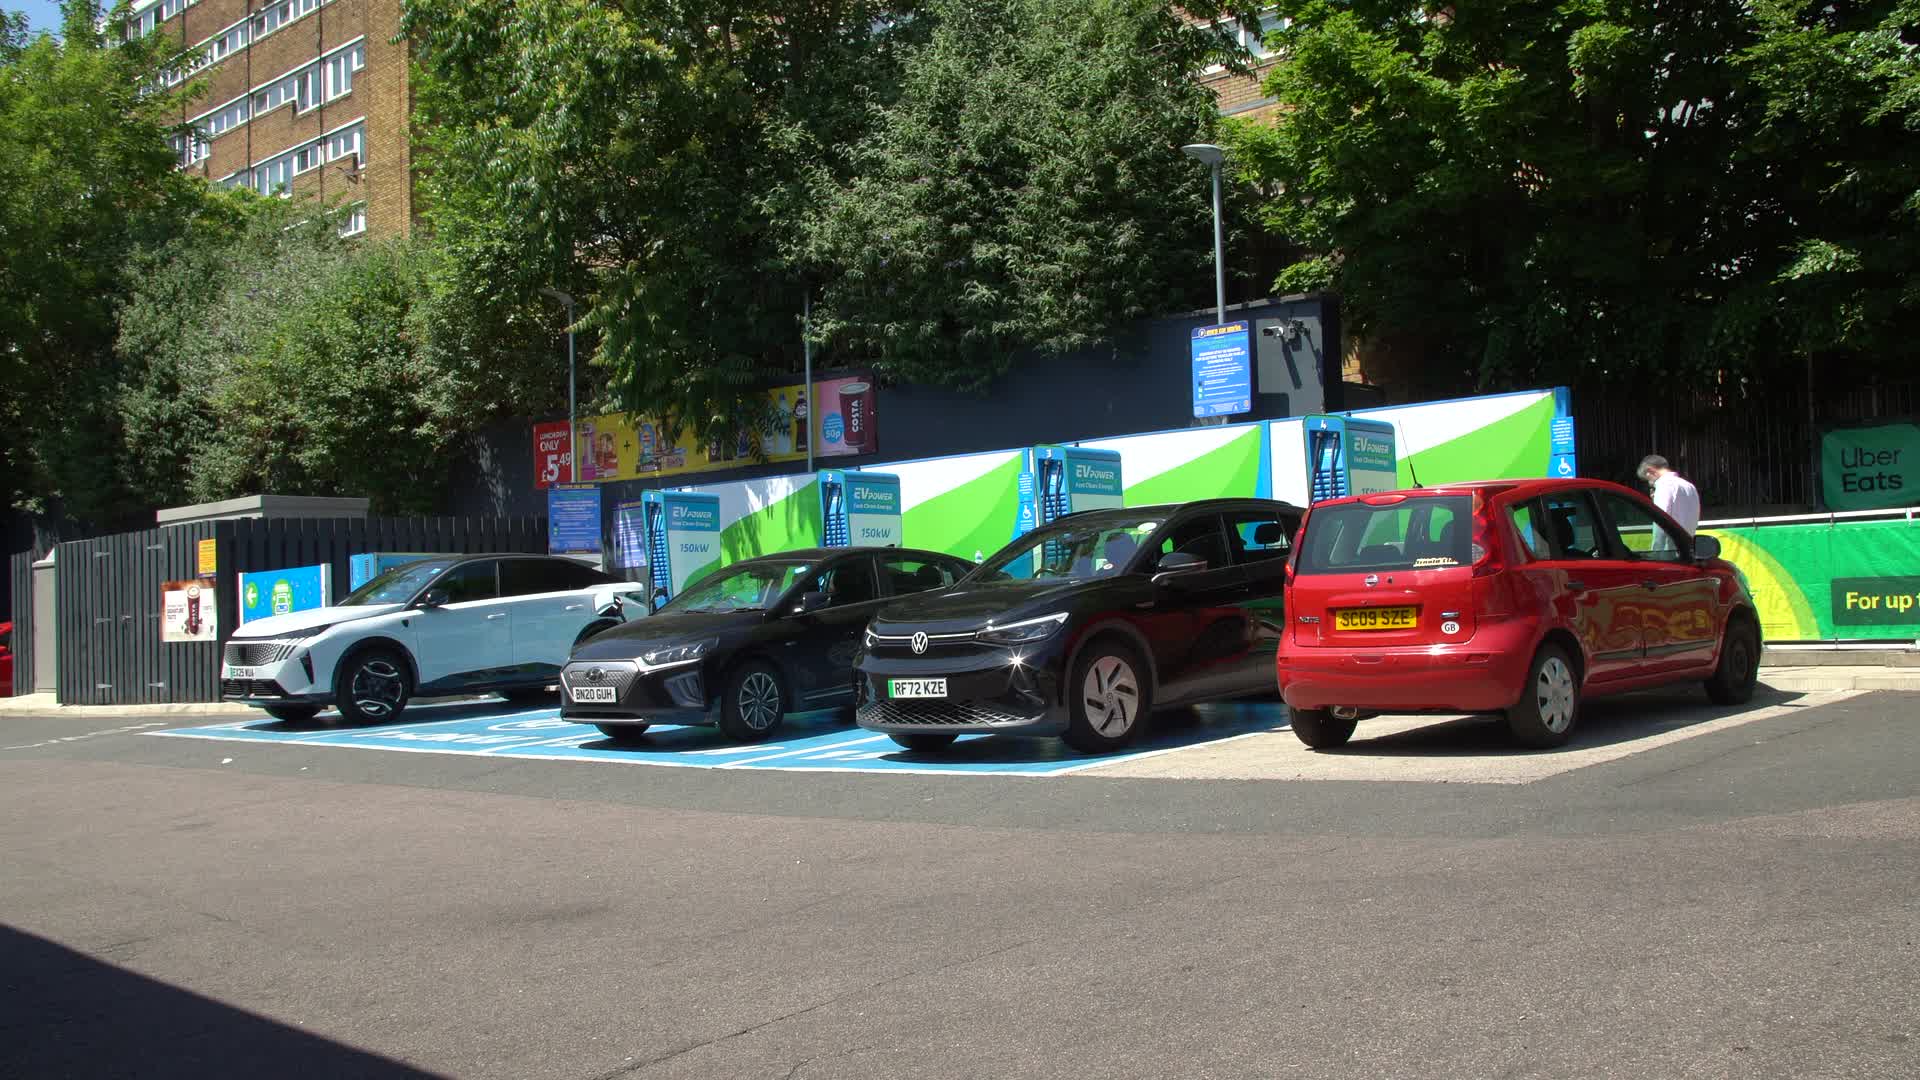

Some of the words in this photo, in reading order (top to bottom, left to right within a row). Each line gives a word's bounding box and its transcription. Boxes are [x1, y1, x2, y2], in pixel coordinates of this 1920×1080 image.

[851, 400, 859, 432] COSTA
[1320, 419, 1328, 430] 4
[825, 429, 841, 440] 50p
[539, 440, 560, 452] ONLY
[1045, 449, 1052, 458] 3
[1841, 447, 1902, 469] Uber
[827, 473, 833, 482] 2
[1842, 472, 1903, 493] Eats
[650, 493, 654, 501] 1
[861, 527, 891, 538] 150kW
[680, 543, 710, 552] 150kW
[1845, 591, 1880, 610] For
[1885, 594, 1914, 613] up
[1342, 611, 1377, 627] SC09
[1380, 609, 1410, 625] SZE
[1444, 622, 1456, 632] GB
[895, 681, 922, 695] RF72
[923, 680, 945, 695] KZE
[575, 688, 595, 700] BN20
[596, 688, 612, 700] GUH
